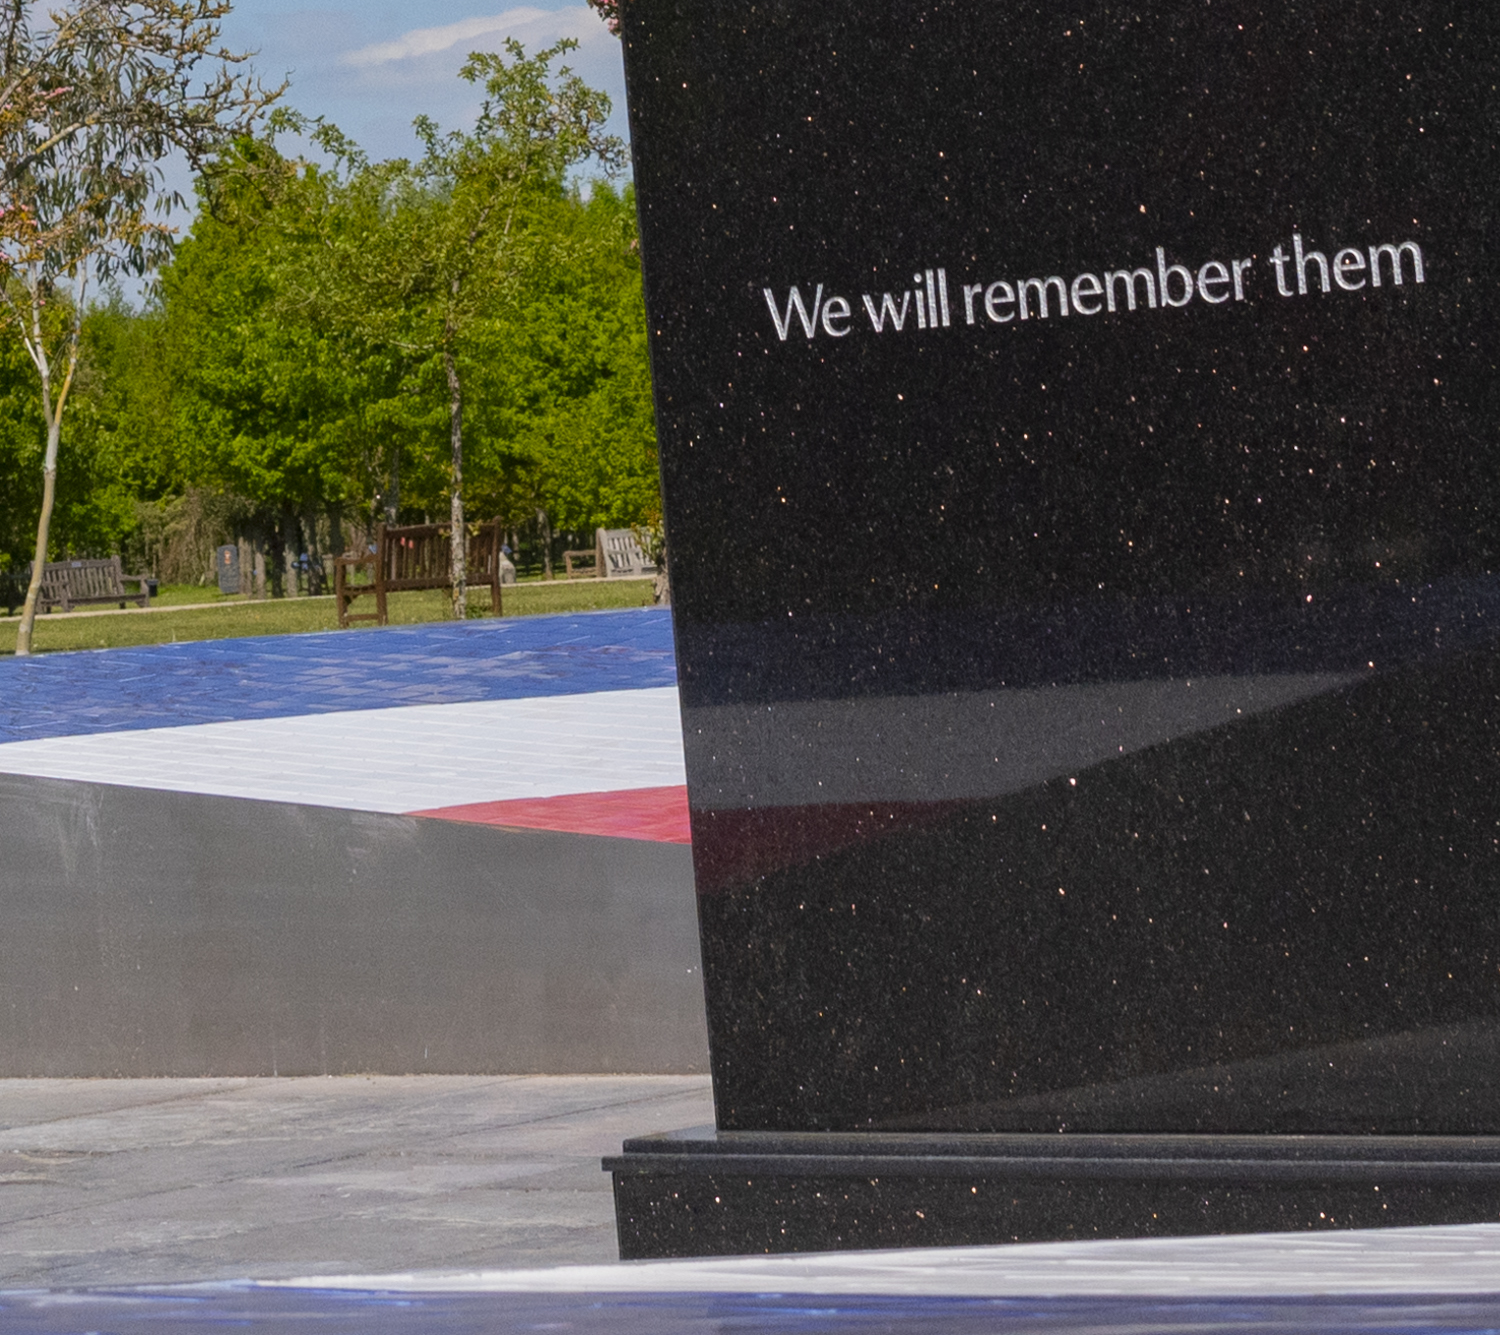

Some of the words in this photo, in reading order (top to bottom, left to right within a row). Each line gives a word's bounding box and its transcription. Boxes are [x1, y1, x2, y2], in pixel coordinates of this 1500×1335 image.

[763, 283, 851, 341] We
[862, 267, 950, 333] will
[963, 246, 1252, 326] remember
[1269, 233, 1425, 297] them
